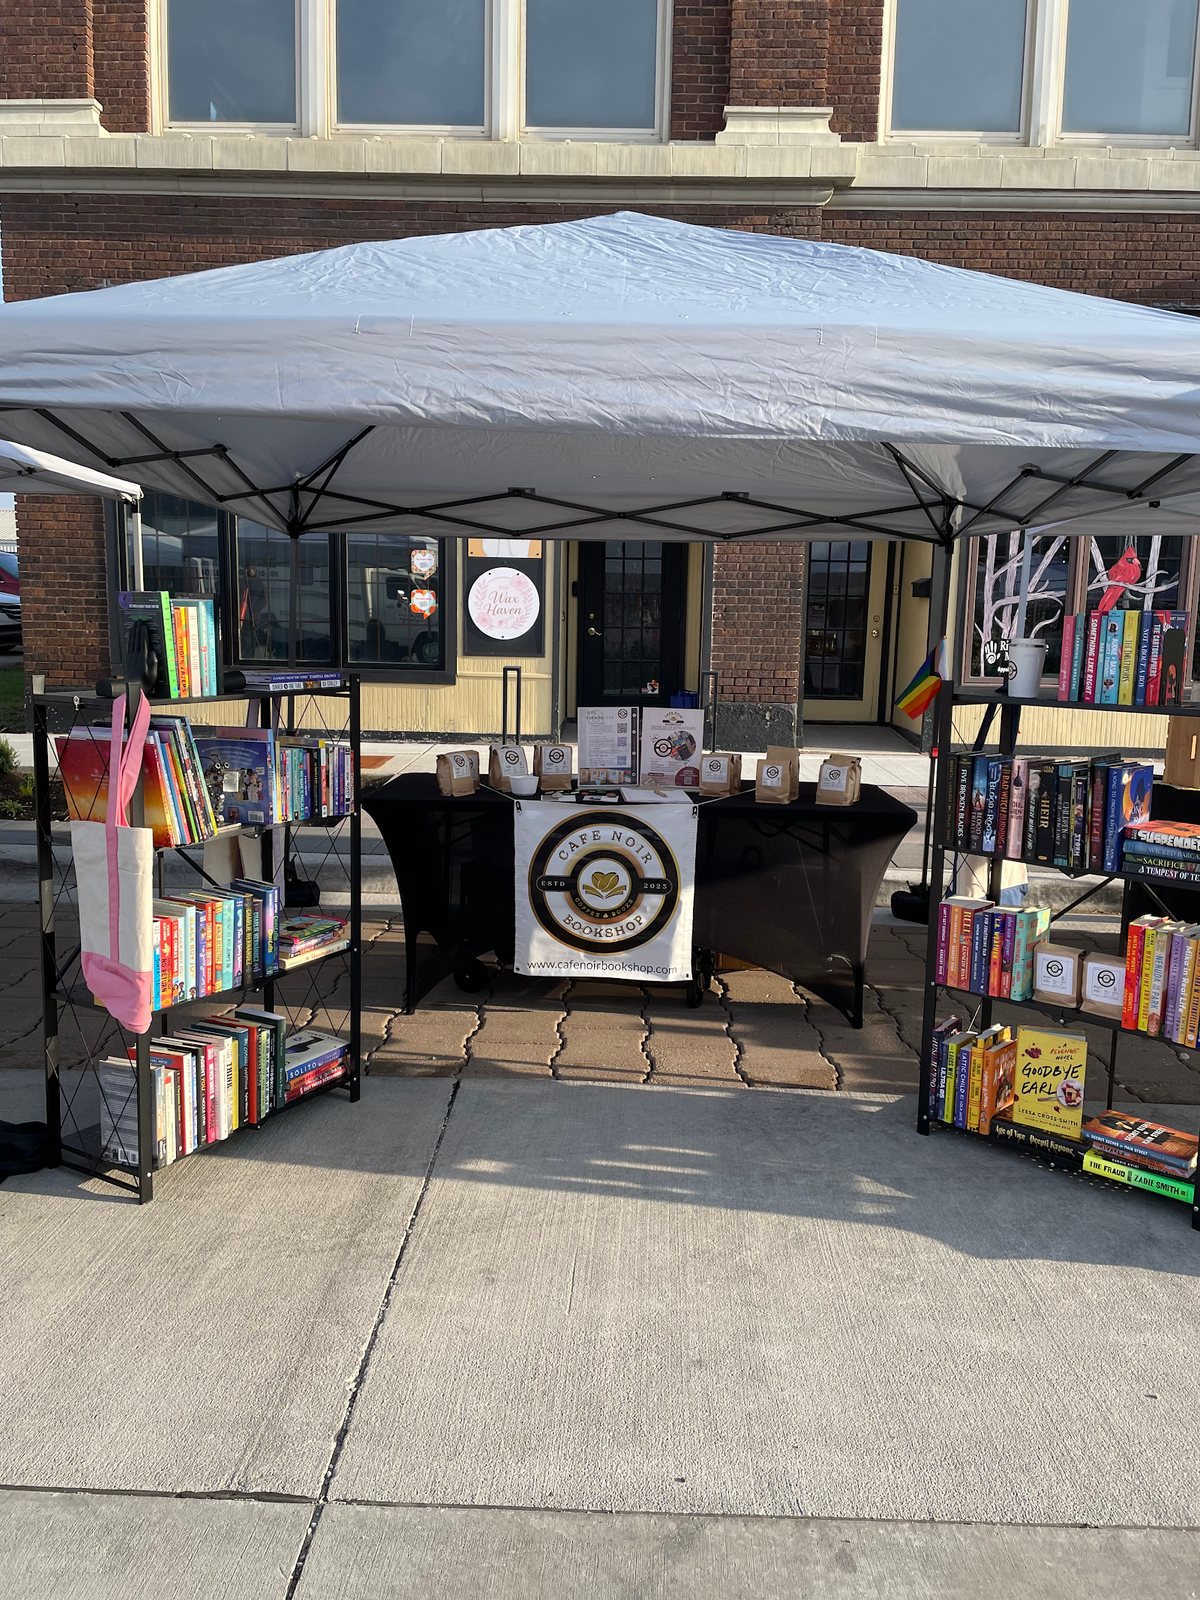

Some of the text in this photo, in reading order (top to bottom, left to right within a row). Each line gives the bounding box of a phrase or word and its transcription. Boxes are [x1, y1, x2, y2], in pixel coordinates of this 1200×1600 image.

[488, 590, 520, 604] Wax
[483, 604, 523, 616] Haven
[1089, 618, 1098, 657] SOMETHING
[1149, 635, 1160, 677] CARTOGRAPHERS
[959, 784, 967, 811] BROKEN
[988, 781, 996, 808] BLOOD
[1000, 791, 1008, 813] WITCH
[1038, 800, 1050, 828] HEIR
[998, 814, 1007, 844] BURNING
[558, 830, 653, 864] CAFE NOIR
[1148, 848, 1176, 856] WICKED
[1143, 857, 1184, 869] SACRIFICE
[1146, 866, 1179, 878] TEMPEST
[574, 897, 600, 918] COFFEE
[611, 899, 634, 917] BOOKS
[563, 914, 644, 938] BOOKSHOP
[963, 911, 971, 934] REEL
[162, 958, 167, 967] NO
[1184, 945, 1193, 965] Mika
[527, 959, 677, 975] www.cafenoirbookshop.com
[1154, 956, 1164, 982] NERUDA
[1150, 991, 1159, 1010] PARK
[1178, 997, 1186, 1013] Life
[1190, 996, 1198, 1033] STRINGFELLOW
[290, 1062, 316, 1078] SOLITO
[322, 1072, 342, 1082] SCREAMING
[1022, 1062, 1083, 1080] GOODBYE
[940, 1089, 944, 1098] 85
[1021, 1081, 1057, 1095] EARL
[1018, 1108, 1078, 1126] LEESA CROSS-SMITH
[995, 1125, 1075, 1157] Age of Vice Deepti Kapoor
[1091, 1134, 1105, 1142] SECRET
[1134, 1147, 1148, 1156] STREET
[1089, 1161, 1180, 1195] THE FRAUD ZADIE SMITH
